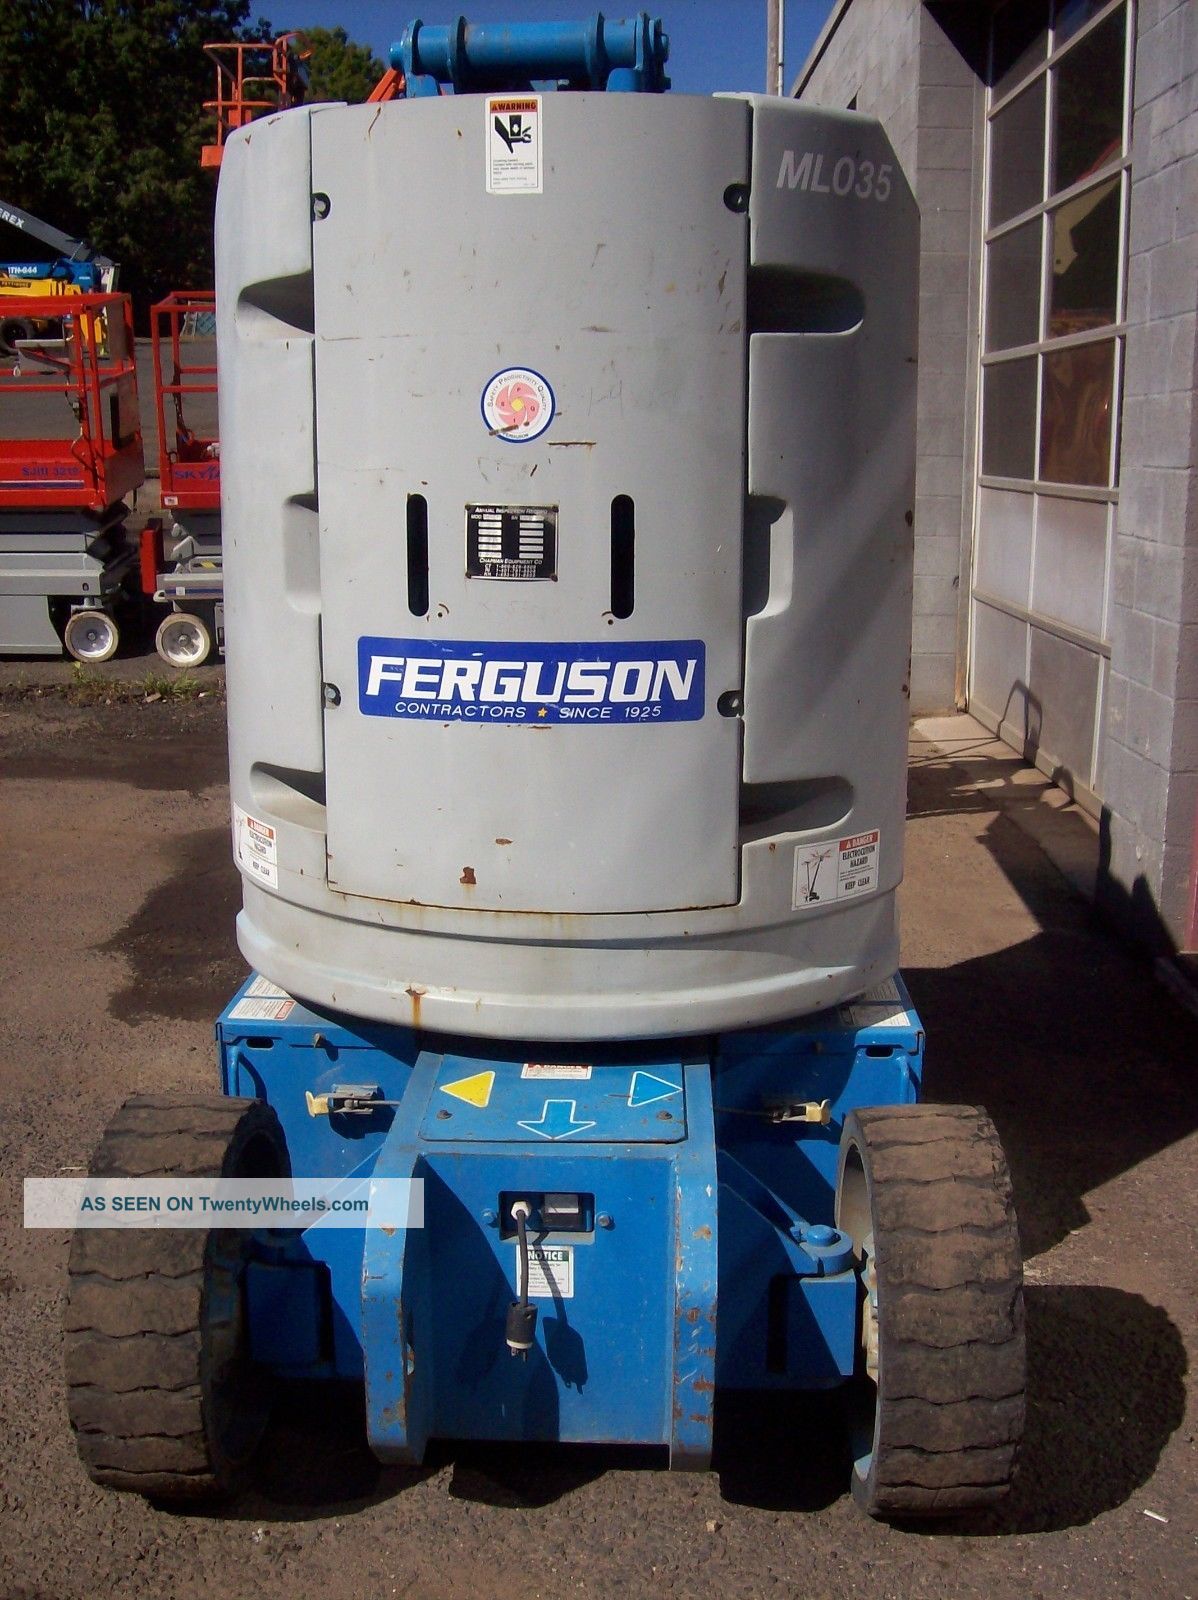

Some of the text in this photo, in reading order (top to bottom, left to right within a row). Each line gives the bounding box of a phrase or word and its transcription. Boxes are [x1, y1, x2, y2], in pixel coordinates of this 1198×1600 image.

[498, 101, 537, 111] WARNING
[364, 655, 698, 703] FERGUSON
[395, 701, 662, 719] CONTRACTORS SINCE 1925
[528, 1251, 563, 1261] NOTICE
